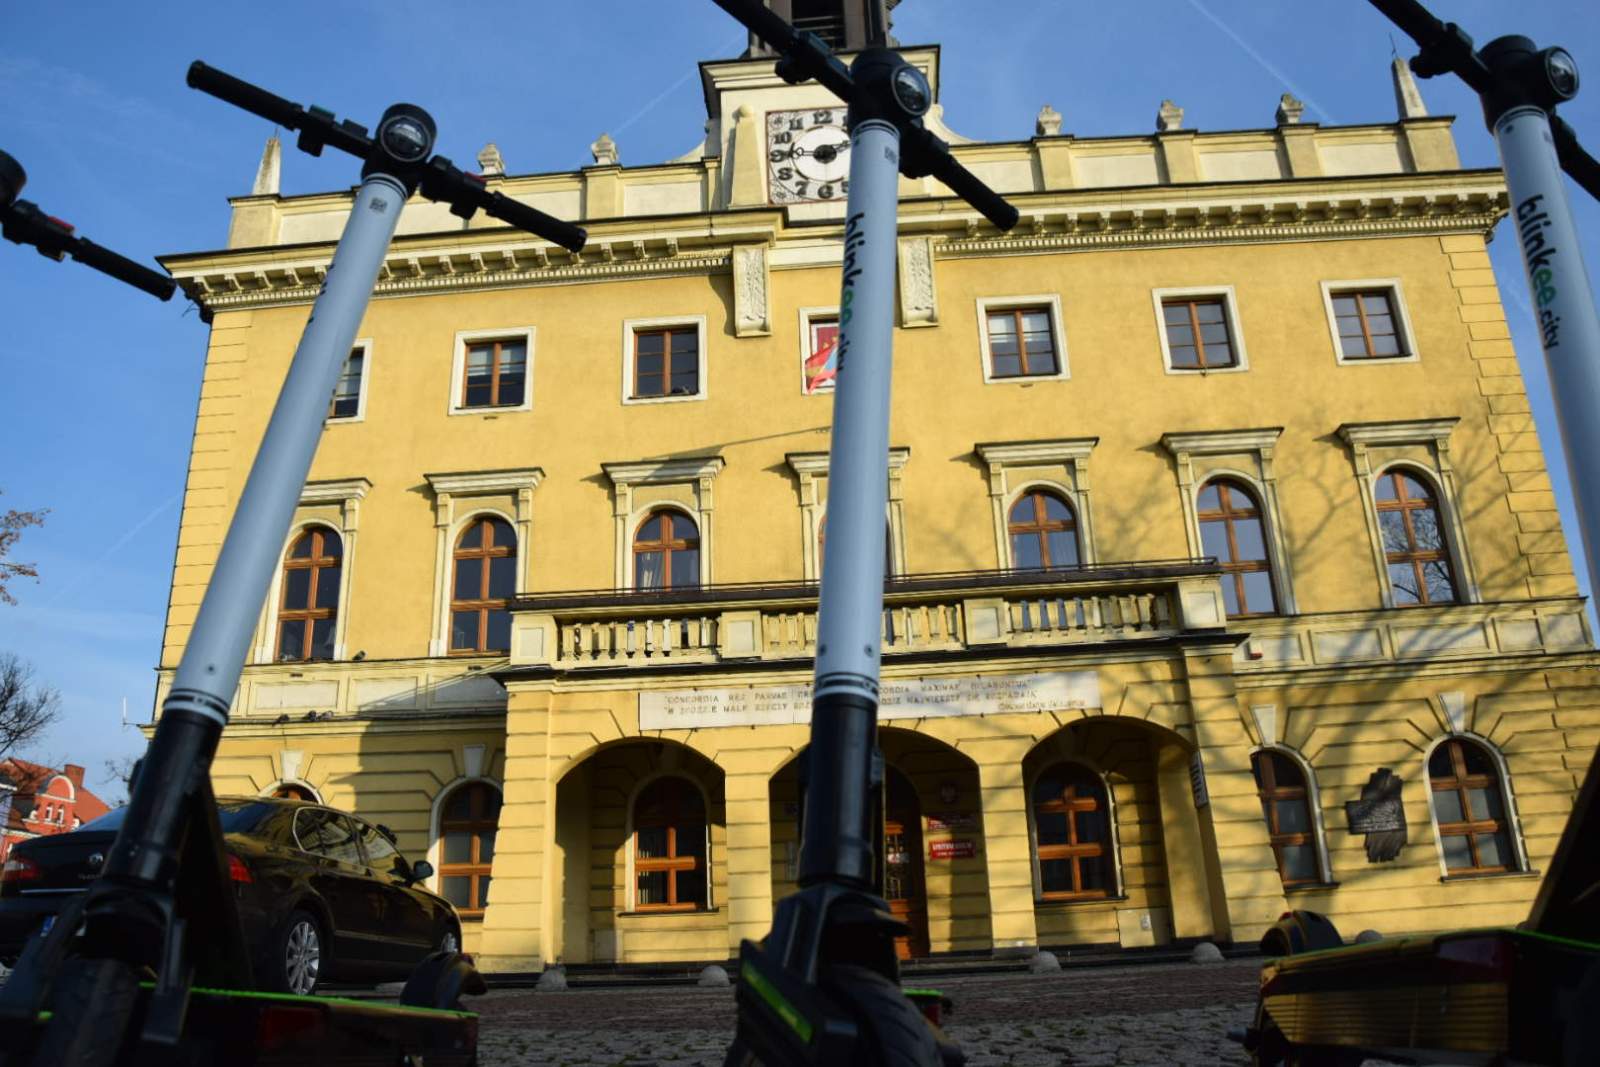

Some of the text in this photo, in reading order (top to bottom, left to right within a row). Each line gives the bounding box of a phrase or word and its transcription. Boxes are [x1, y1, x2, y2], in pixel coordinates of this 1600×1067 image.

[813, 111, 833, 124] 12
[789, 118, 804, 131] 11
[773, 132, 792, 144] 10
[770, 150, 786, 163] 9
[778, 167, 793, 181] 8
[795, 181, 809, 196] 7
[817, 185, 834, 199] 6
[1518, 195, 1560, 348] blinkee.city
